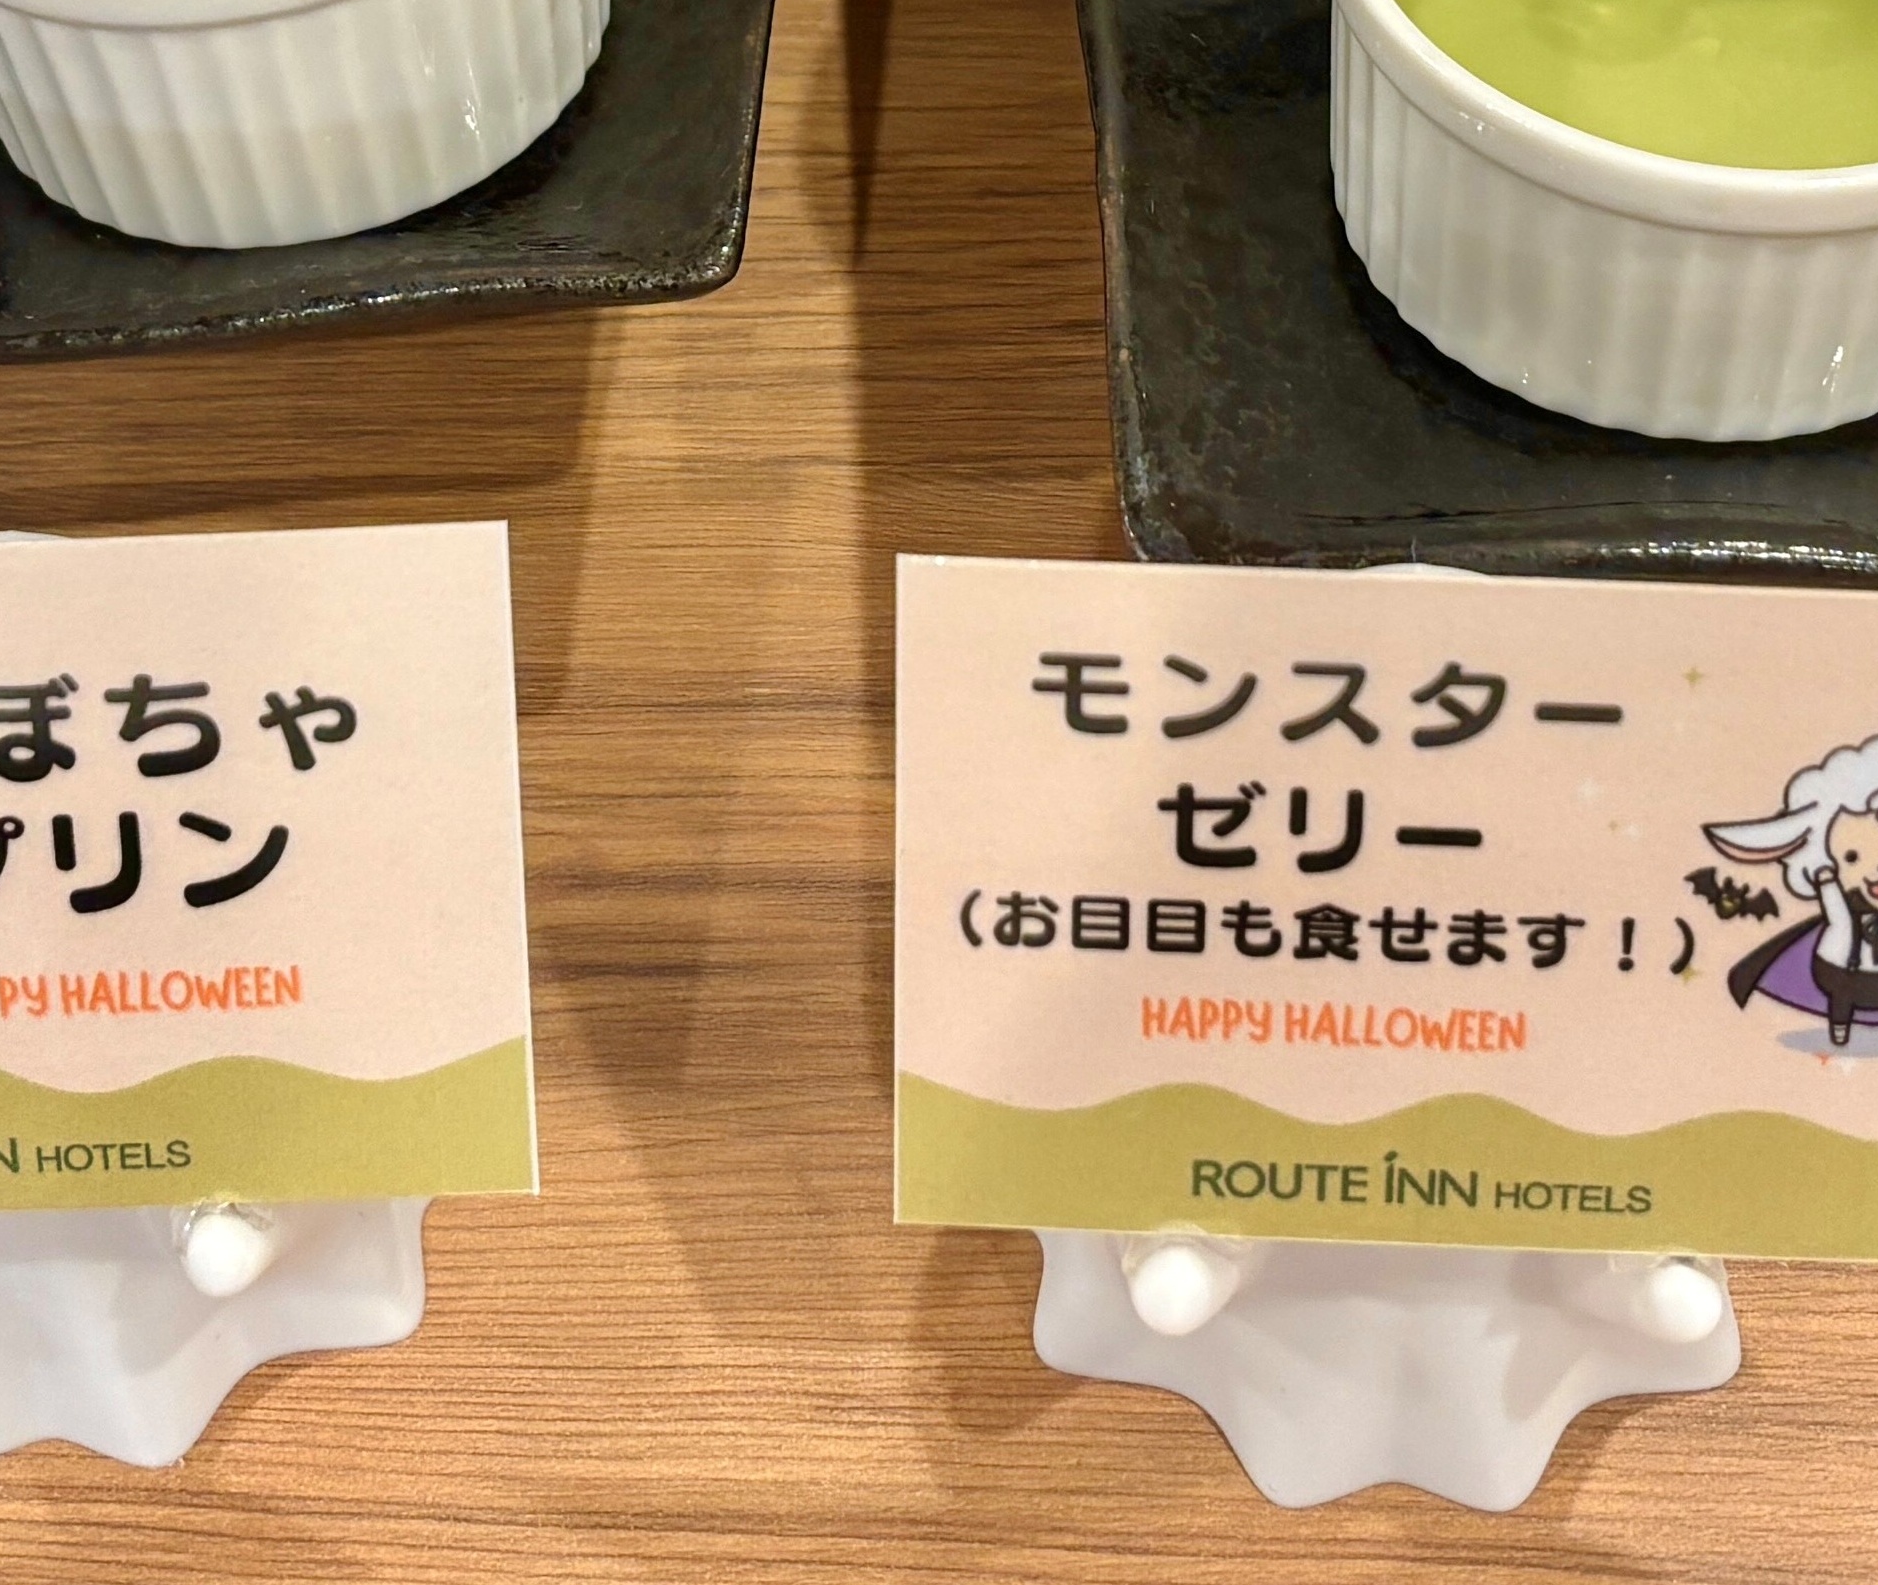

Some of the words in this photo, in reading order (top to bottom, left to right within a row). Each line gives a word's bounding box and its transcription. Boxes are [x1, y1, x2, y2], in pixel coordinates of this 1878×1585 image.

[1031, 651, 1625, 749] モンスター
[1159, 783, 1484, 874] ゼリー
[60, 965, 302, 1014] HALLOWEEN
[1140, 997, 1274, 1044] HAPPY
[1283, 1005, 1527, 1052] HALLOWEEN
[35, 1139, 192, 1172] HOTELS
[1190, 1159, 1368, 1203] ROUTE
[1494, 1181, 1652, 1213] HOTELS
